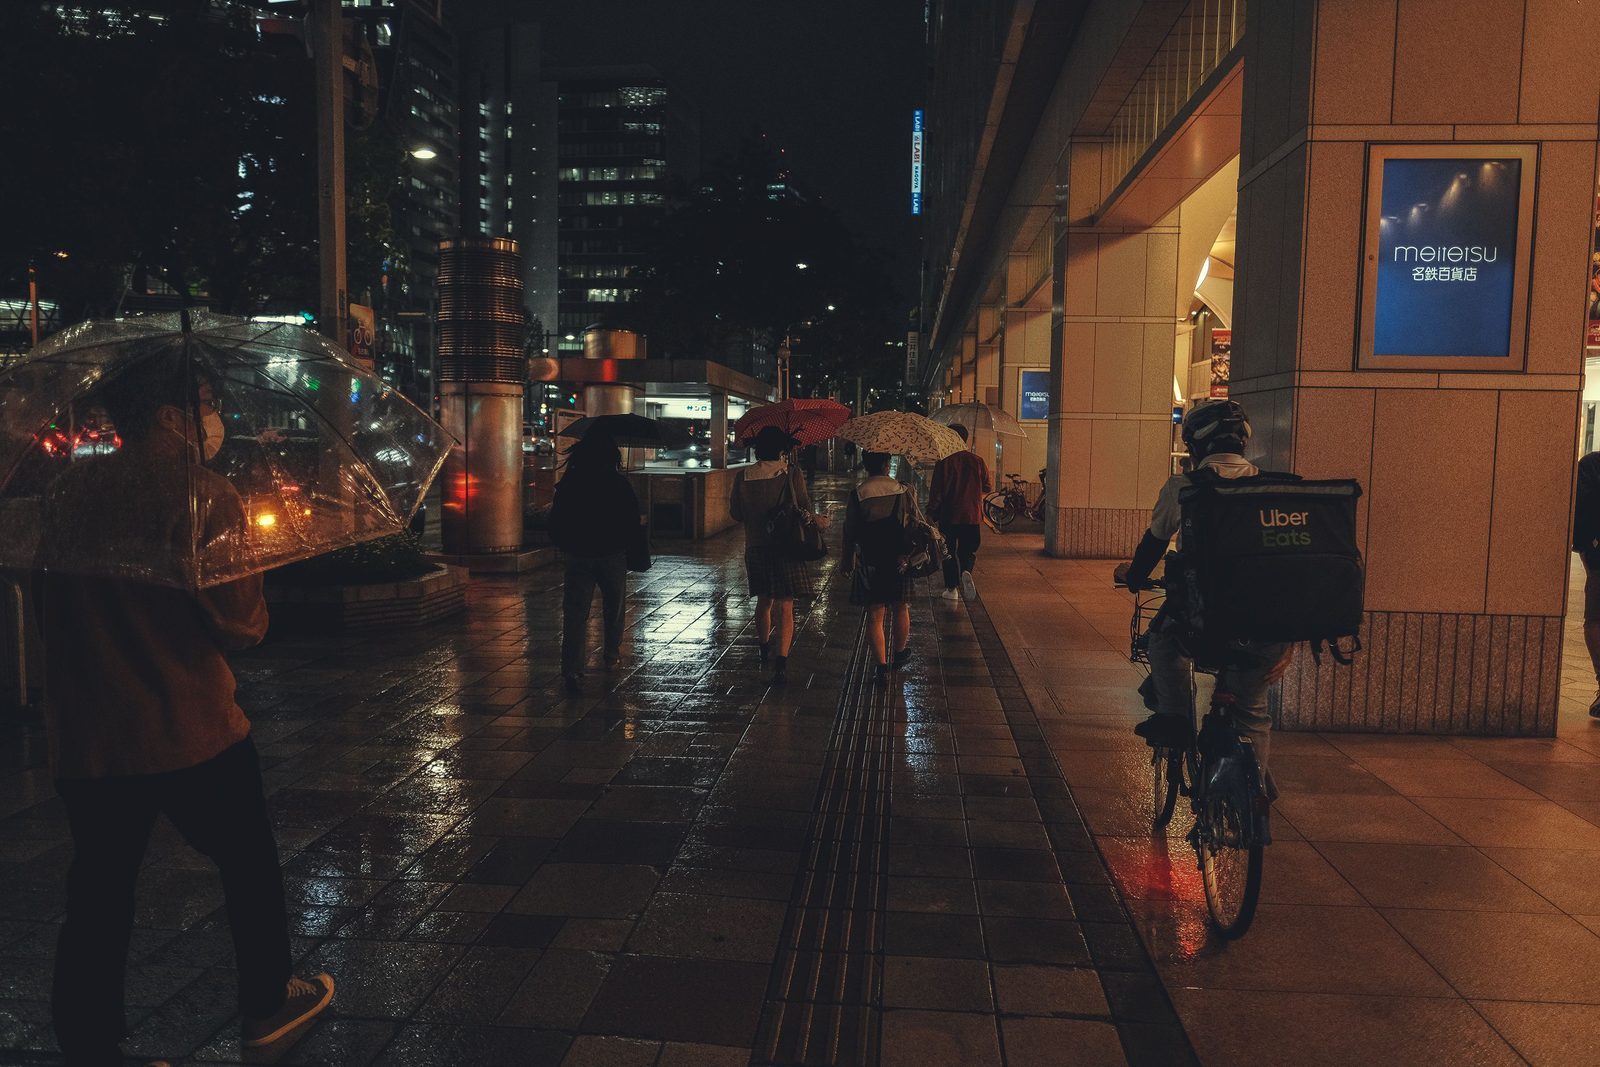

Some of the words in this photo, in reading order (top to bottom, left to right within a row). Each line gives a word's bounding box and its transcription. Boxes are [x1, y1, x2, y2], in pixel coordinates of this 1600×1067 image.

[1394, 246, 1497, 262] meitetsu
[1412, 266, 1478, 282] 名鉄百貨店
[1259, 509, 1309, 527] Uber
[1262, 529, 1312, 547] Eats
